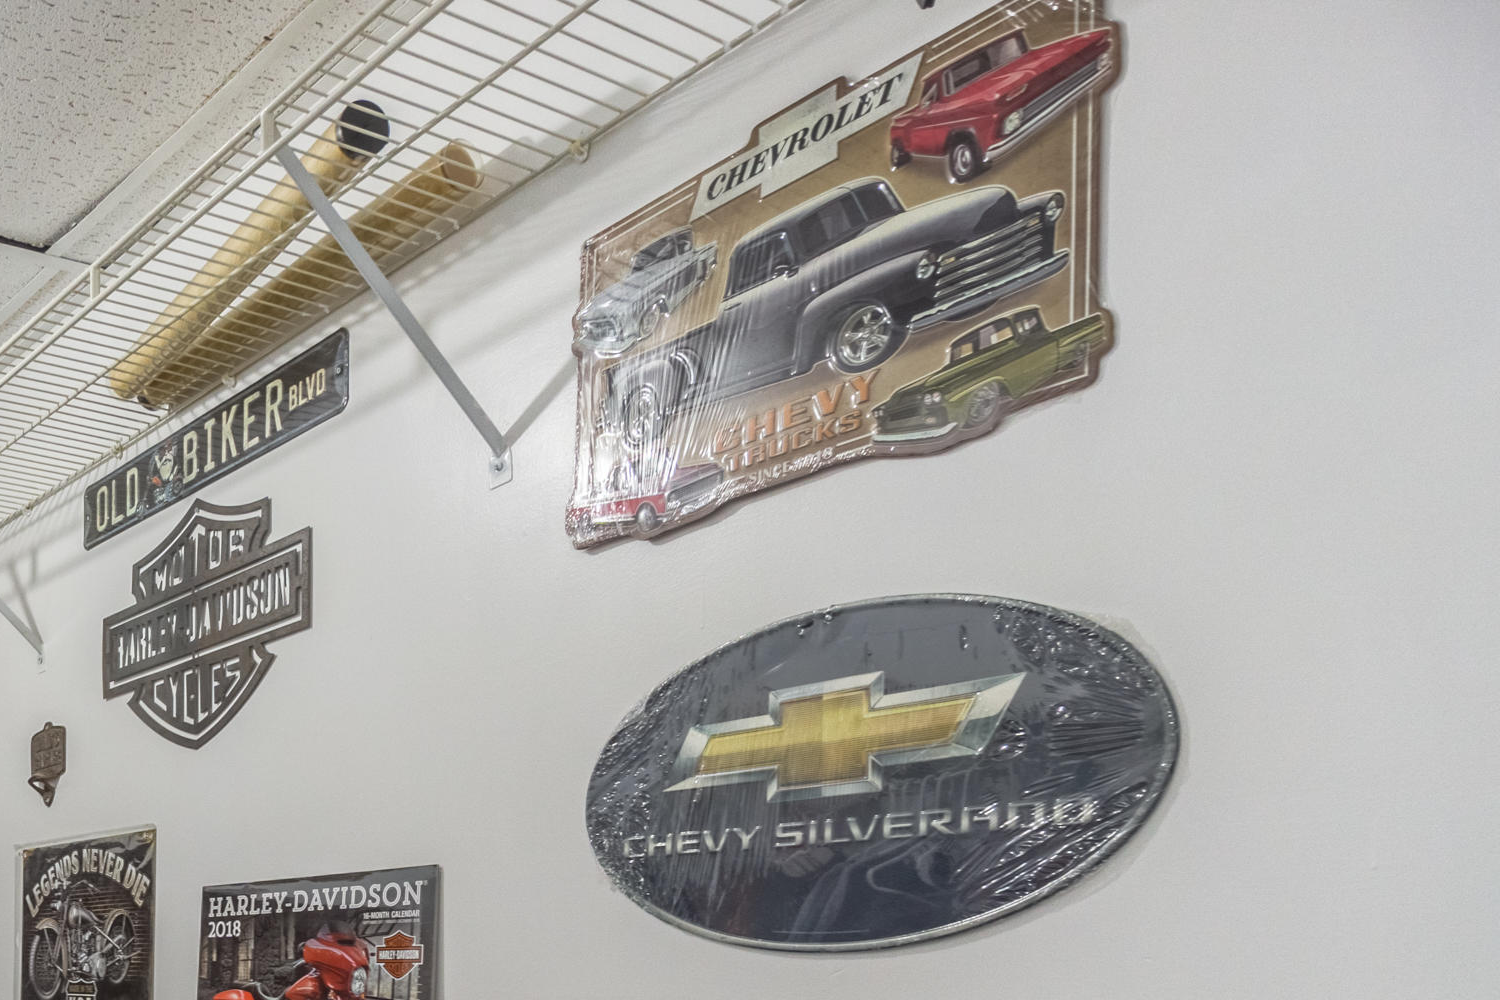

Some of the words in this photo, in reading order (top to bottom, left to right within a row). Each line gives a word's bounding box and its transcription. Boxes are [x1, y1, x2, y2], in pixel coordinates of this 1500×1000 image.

[706, 73, 904, 202] CHEVROLET
[714, 369, 879, 454] CHEVY
[721, 410, 862, 472] TRUCKS
[95, 467, 140, 533] OLD
[182, 378, 283, 485] BIKER
[288, 367, 326, 411] BLVD
[153, 656, 241, 725] CYCLES
[622, 825, 760, 859] CHEVY
[775, 799, 1097, 849] SILVERADO
[25, 850, 80, 918] LEGENDS
[82, 848, 125, 883] NEVER
[122, 863, 151, 907] DIE
[208, 880, 423, 918] HARLEY-DAVIDSON
[391, 909, 420, 919] CALENDAR
[207, 920, 242, 938] 2018
